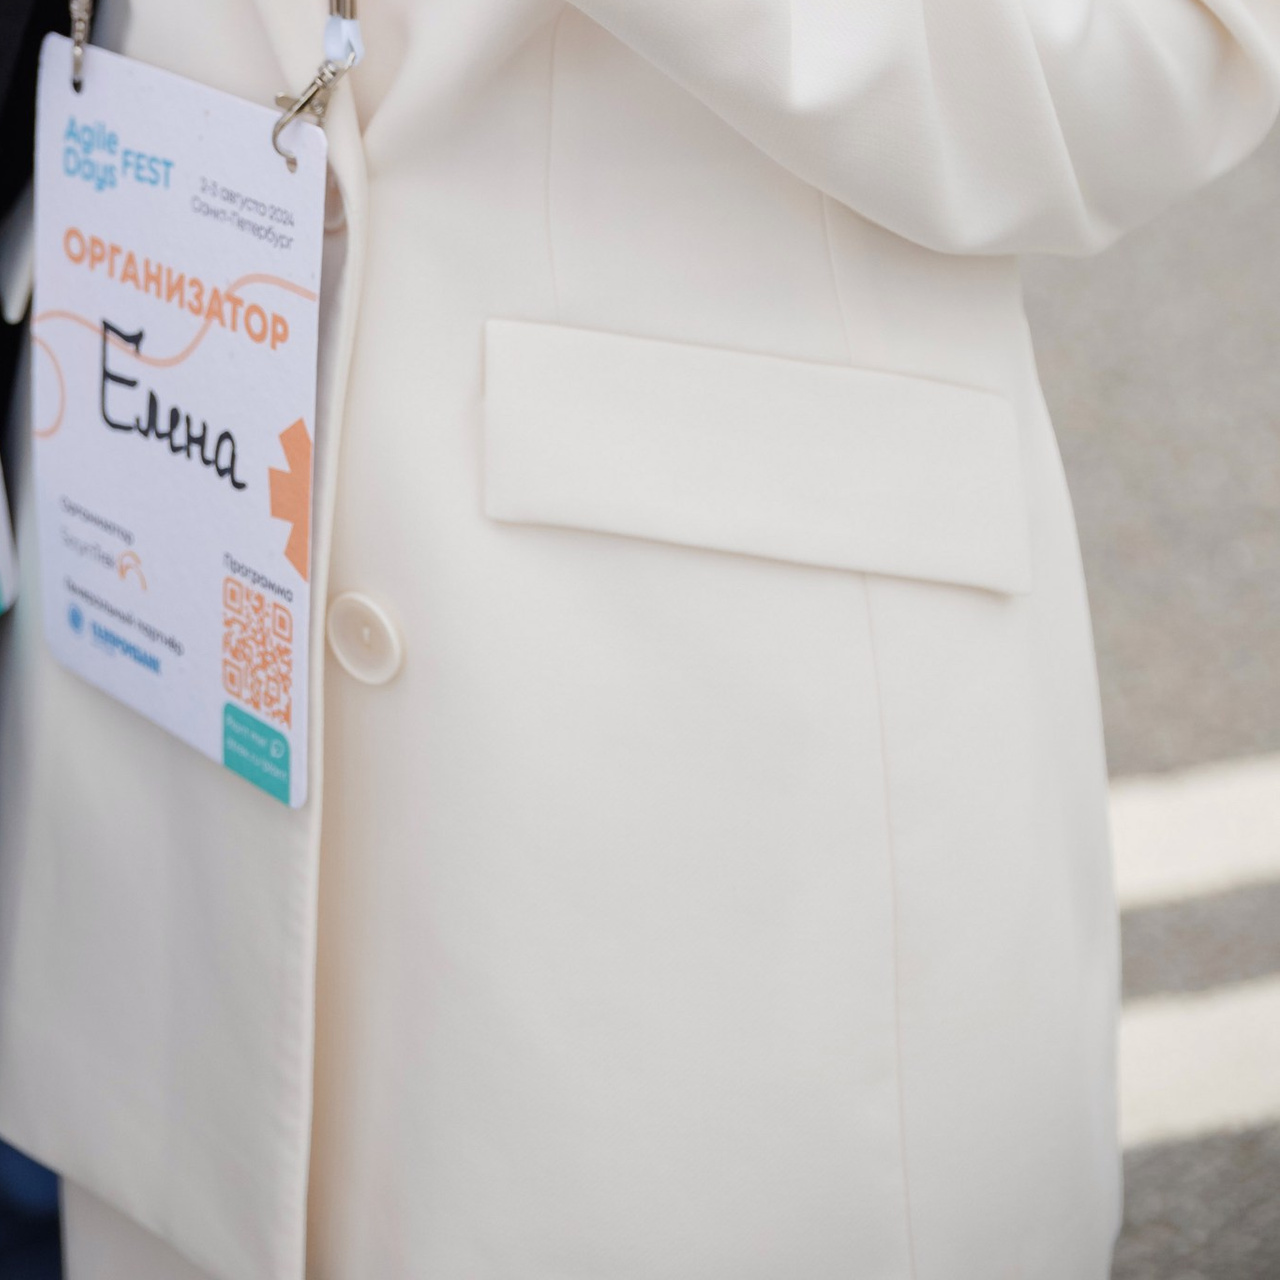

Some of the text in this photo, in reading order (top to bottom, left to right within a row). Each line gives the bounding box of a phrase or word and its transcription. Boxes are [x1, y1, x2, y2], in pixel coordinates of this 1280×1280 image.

[63, 115, 118, 155] Agile
[62, 146, 118, 191] Days
[121, 148, 175, 190] FEST
[62, 226, 289, 351] ОРГАНИЗАТОР
[101, 318, 248, 490] Елена
